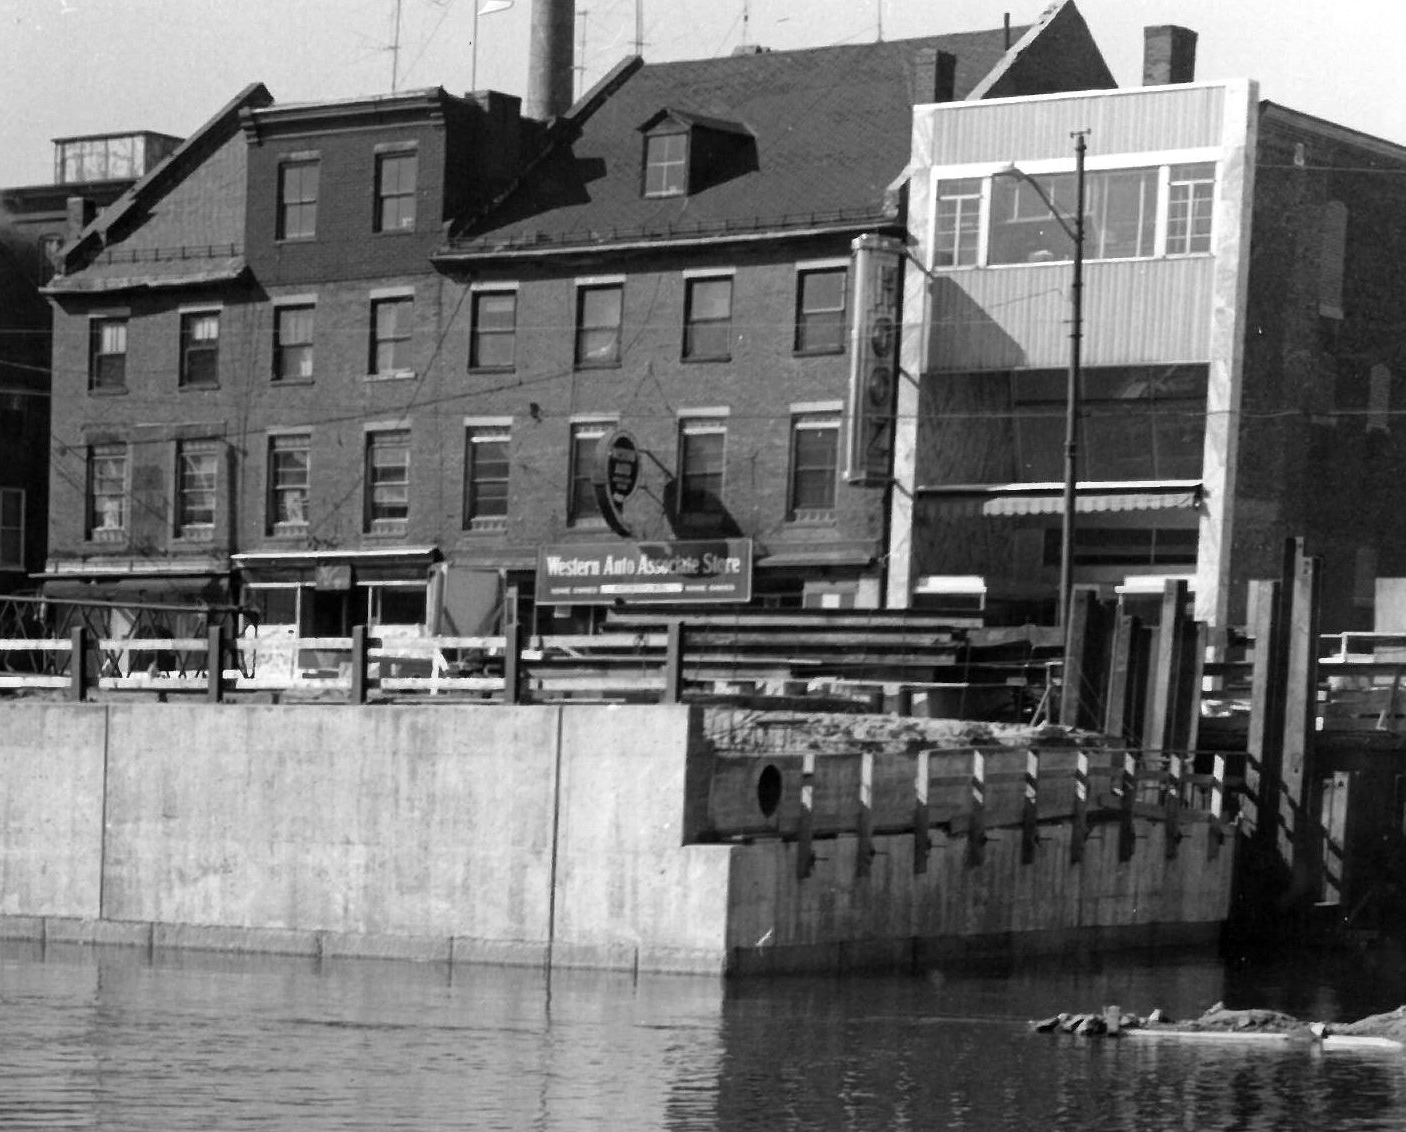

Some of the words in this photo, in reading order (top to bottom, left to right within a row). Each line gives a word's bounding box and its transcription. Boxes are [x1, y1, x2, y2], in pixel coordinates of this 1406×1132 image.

[546, 556, 600, 576] Western
[602, 554, 635, 575] Auto
[636, 554, 699, 575] Associate
[703, 552, 741, 574] Store
